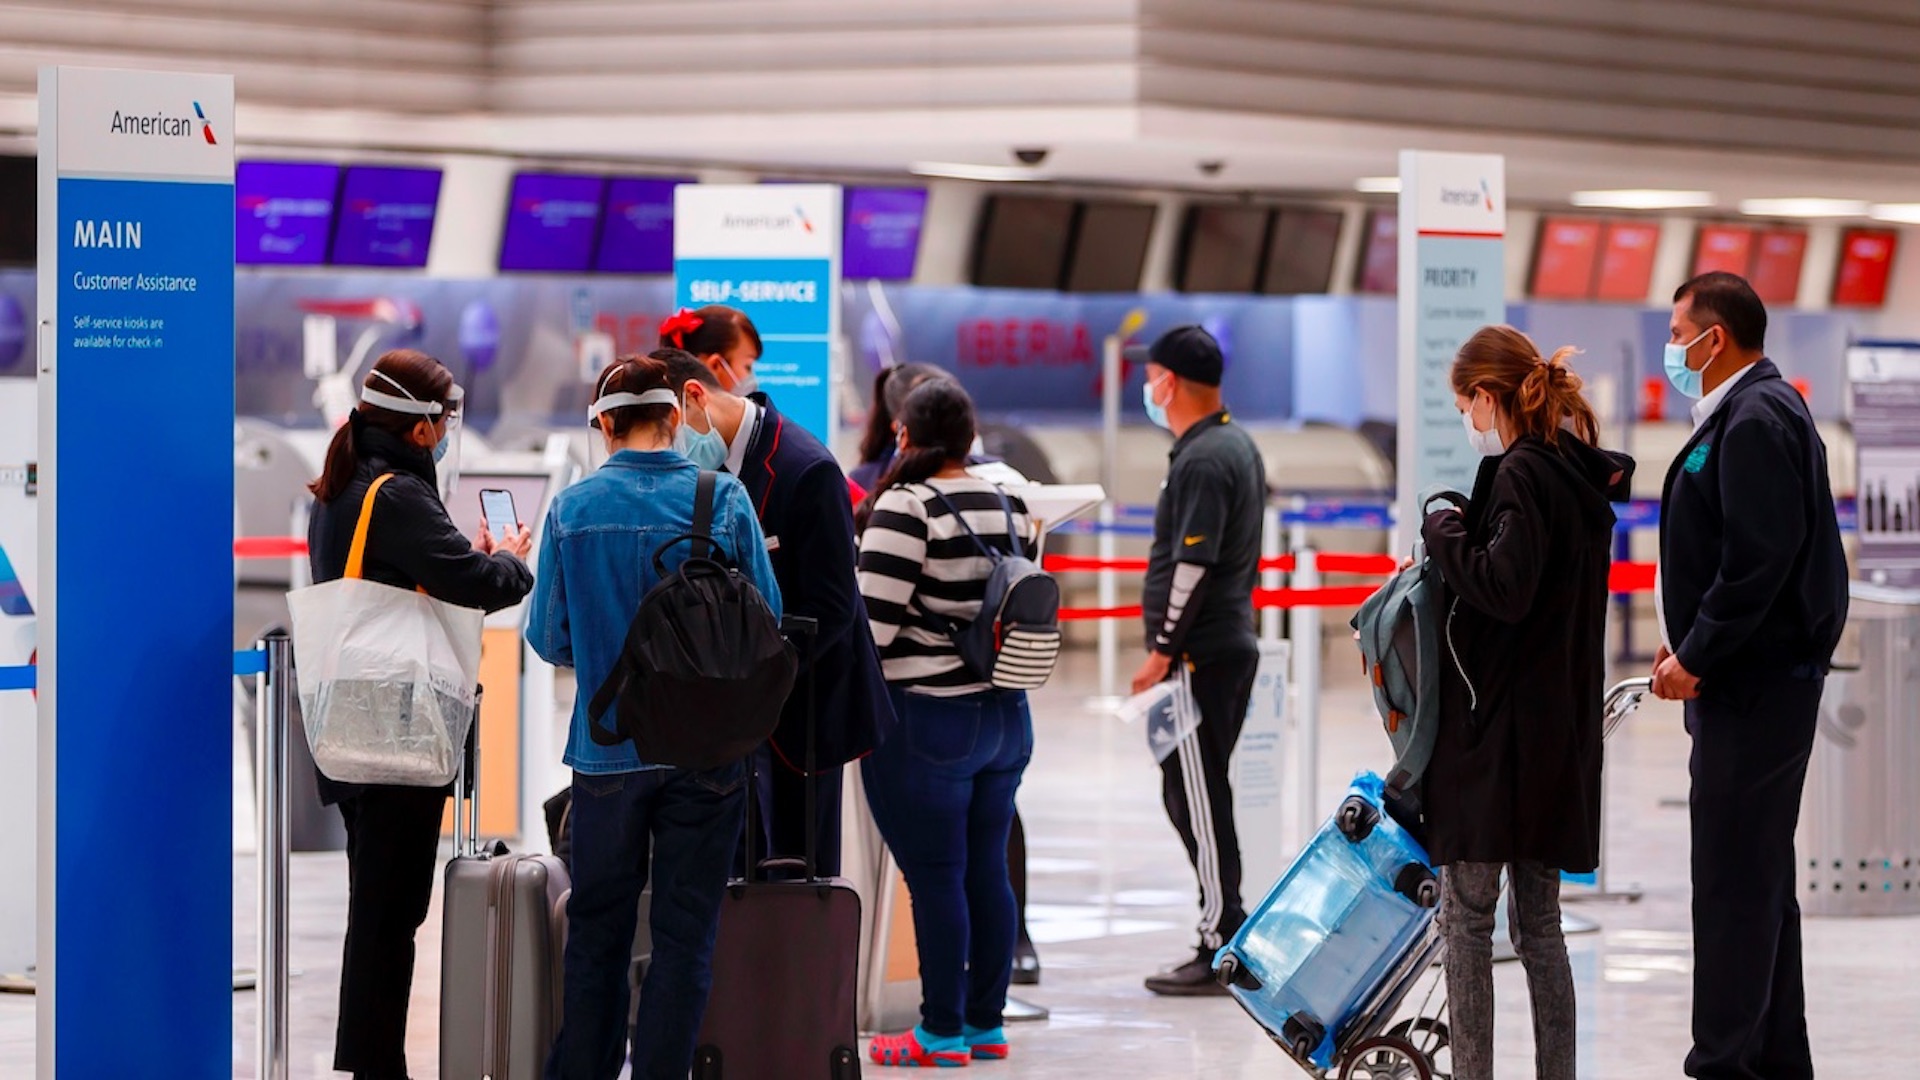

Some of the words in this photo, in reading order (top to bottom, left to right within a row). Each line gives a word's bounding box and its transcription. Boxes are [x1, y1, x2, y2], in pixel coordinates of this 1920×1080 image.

[111, 110, 191, 137] American
[722, 211, 792, 229] American
[73, 219, 142, 250] MAIN
[73, 271, 133, 291] Customer
[135, 272, 197, 292] Assistance
[1424, 267, 1478, 288] PRIORITY
[690, 280, 817, 303] SELF-SERVICE
[73, 314, 123, 329] Self-service
[124, 316, 149, 330] kiosks
[149, 318, 164, 330] are
[73, 333, 112, 348] available
[112, 334, 126, 348] for
[127, 335, 163, 349] check-in
[957, 317, 1094, 369] IBERIA
